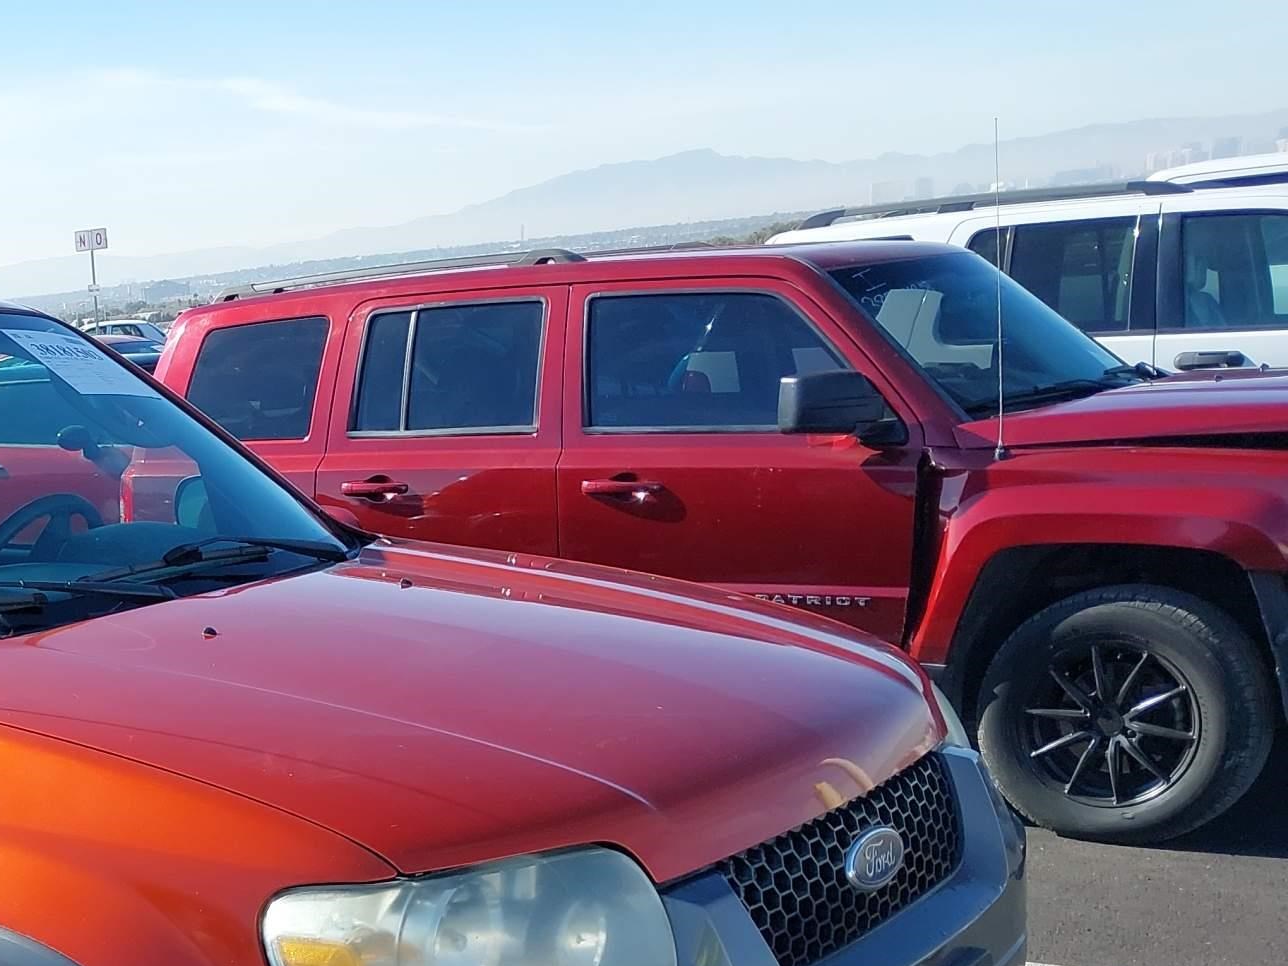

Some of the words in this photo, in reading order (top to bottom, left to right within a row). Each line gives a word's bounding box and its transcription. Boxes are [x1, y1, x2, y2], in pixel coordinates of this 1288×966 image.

[79, 233, 86, 247] N
[755, 594, 871, 606] PATRIOT
[865, 839, 896, 878] Ford
